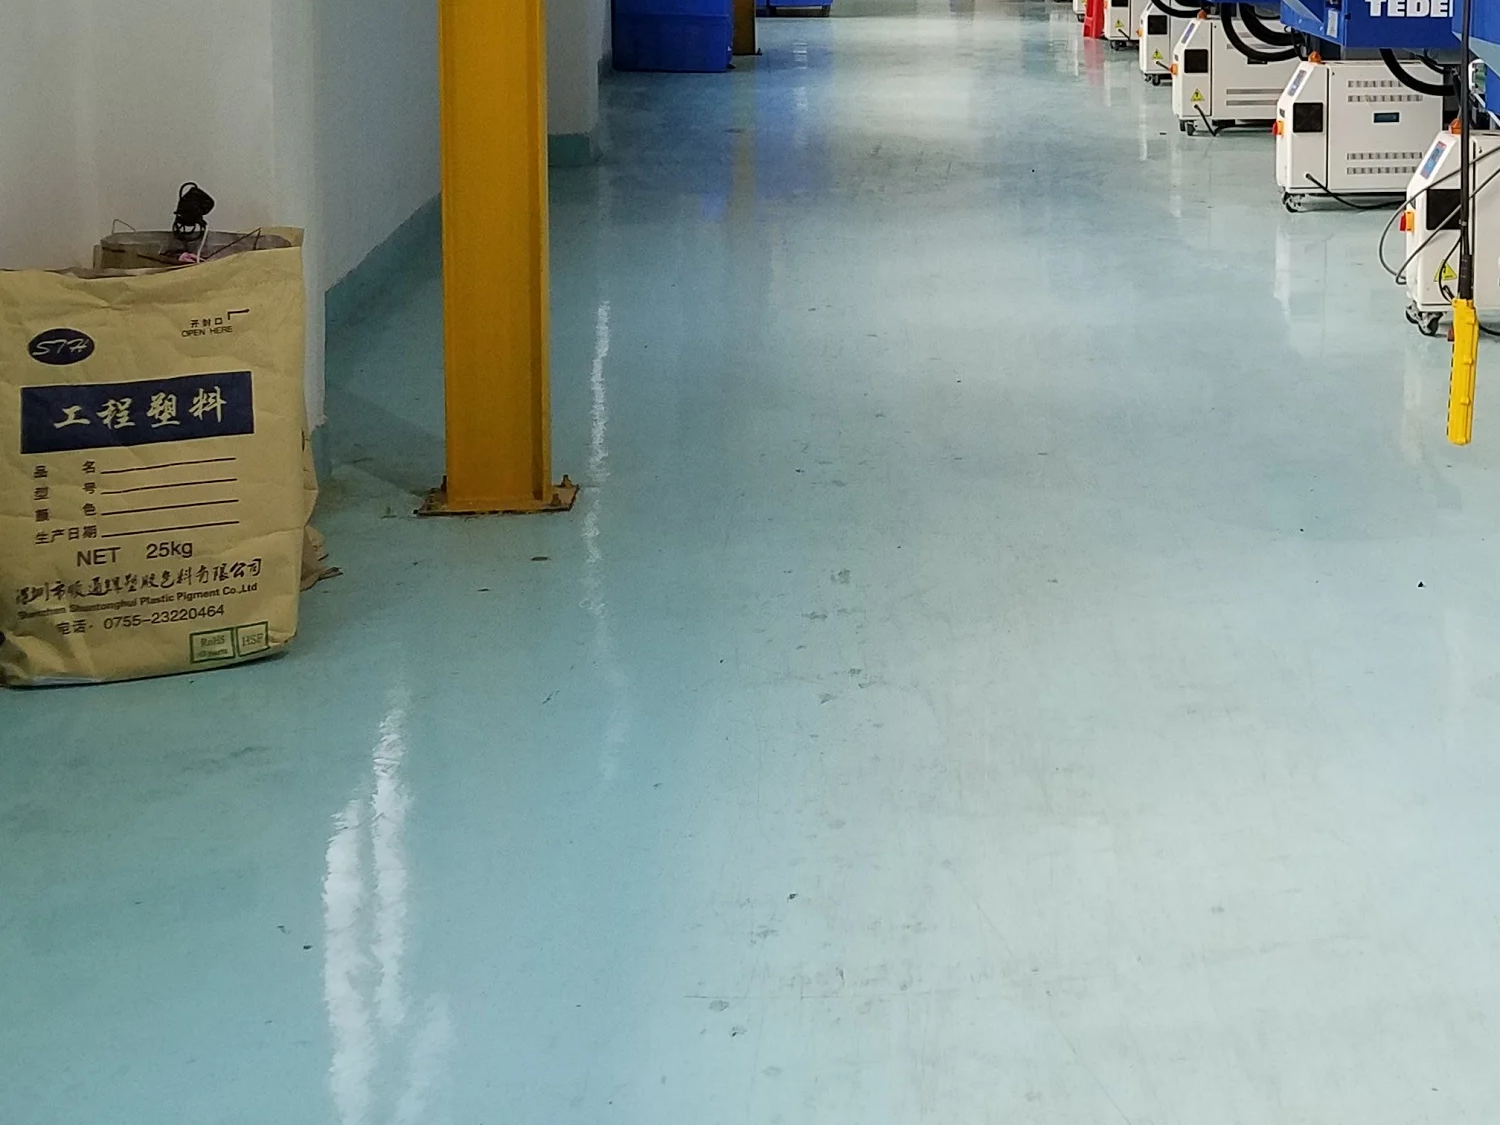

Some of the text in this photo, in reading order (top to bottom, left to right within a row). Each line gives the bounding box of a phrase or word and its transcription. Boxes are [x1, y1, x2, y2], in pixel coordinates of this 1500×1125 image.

[182, 325, 233, 338] OPEN HERE
[190, 317, 223, 328] 开封口
[53, 385, 227, 429] 工程塑料
[35, 525, 97, 545] 生产日期
[77, 541, 193, 567] NET 25kg
[140, 593, 174, 606] Plastic
[176, 588, 221, 602] Pigment
[103, 604, 226, 630] 0755-23220464
